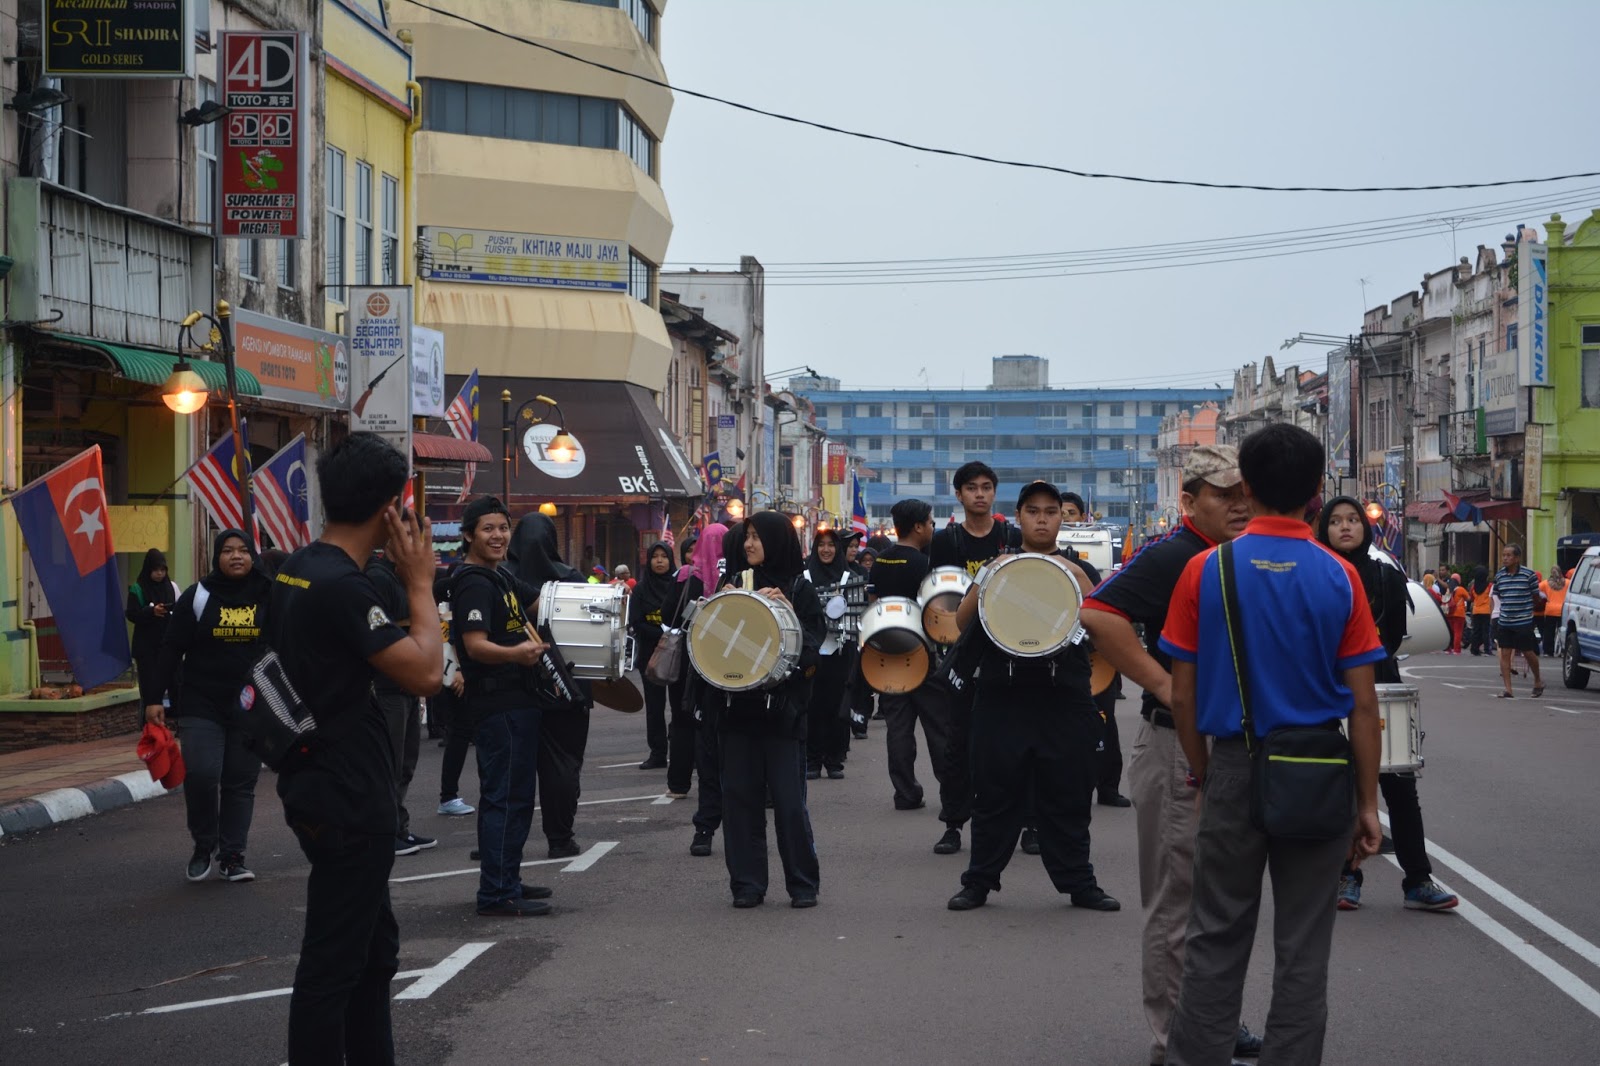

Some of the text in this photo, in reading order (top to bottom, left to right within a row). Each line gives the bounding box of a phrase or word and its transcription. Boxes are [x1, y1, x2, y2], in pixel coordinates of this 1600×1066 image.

[114, 28, 179, 41] SHADIRA
[81, 54, 144, 65] GOLD SERIES
[228, 38, 294, 88] 4D
[230, 95, 262, 106] TOTO
[230, 115, 291, 137] 5D 6D
[227, 194, 280, 206] SUPREME
[231, 210, 282, 219] POWER
[240, 223, 268, 234] MEGA
[484, 244, 517, 255] TUISYEN
[488, 235, 619, 261] PUSAT IKHTIAR MAJU JAYA
[356, 326, 400, 337] SEGAMAT
[1534, 283, 1544, 382] DAIKIN
[242, 335, 262, 353] AGENSI
[352, 338, 403, 349] SENJATAPI
[260, 361, 296, 382] SPORTS TOTO
[635, 445, 659, 492] RESTORAN
[618, 475, 649, 493] BK
[213, 628, 234, 637] GREEN
[948, 667, 964, 690] VIC
